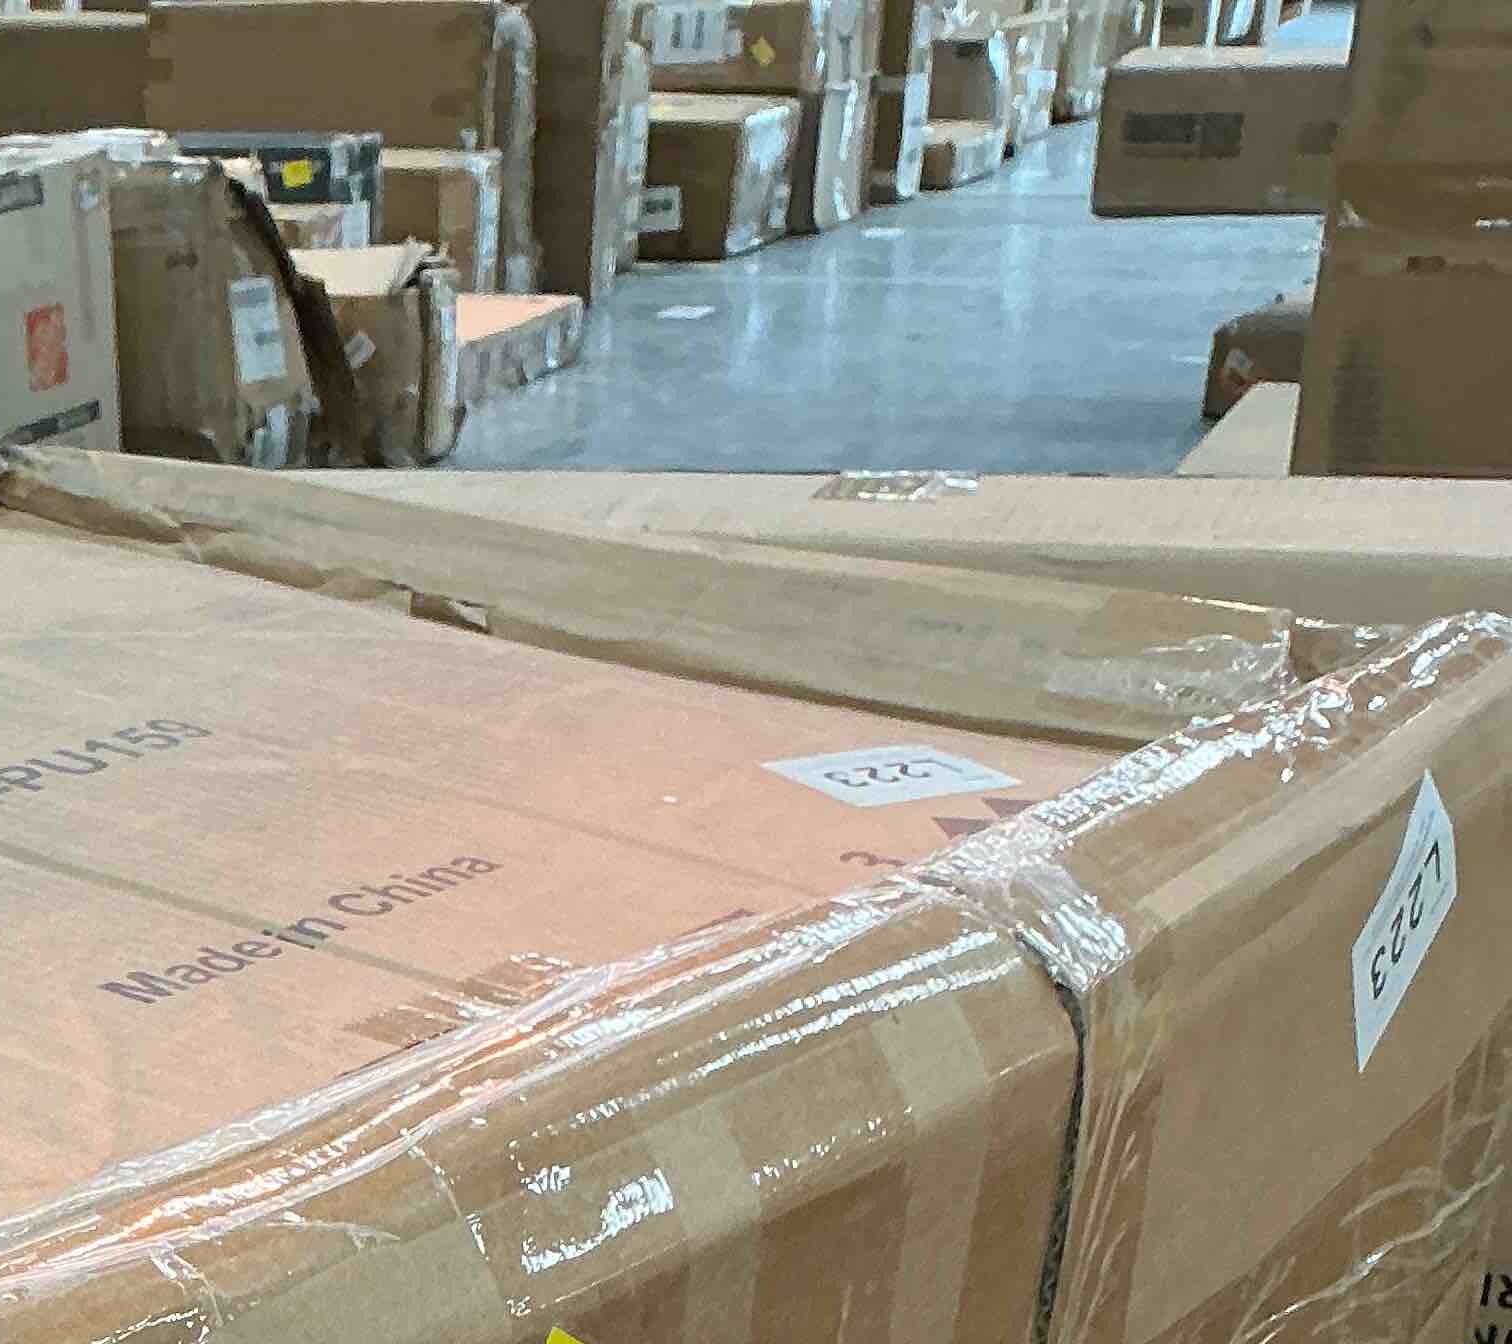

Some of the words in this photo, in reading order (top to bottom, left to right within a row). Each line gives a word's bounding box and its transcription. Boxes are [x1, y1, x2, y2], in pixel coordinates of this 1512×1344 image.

[99, 930, 264, 1005] Made
[261, 914, 335, 950] in
[326, 850, 502, 918] China
[1370, 840, 1442, 999] L223
